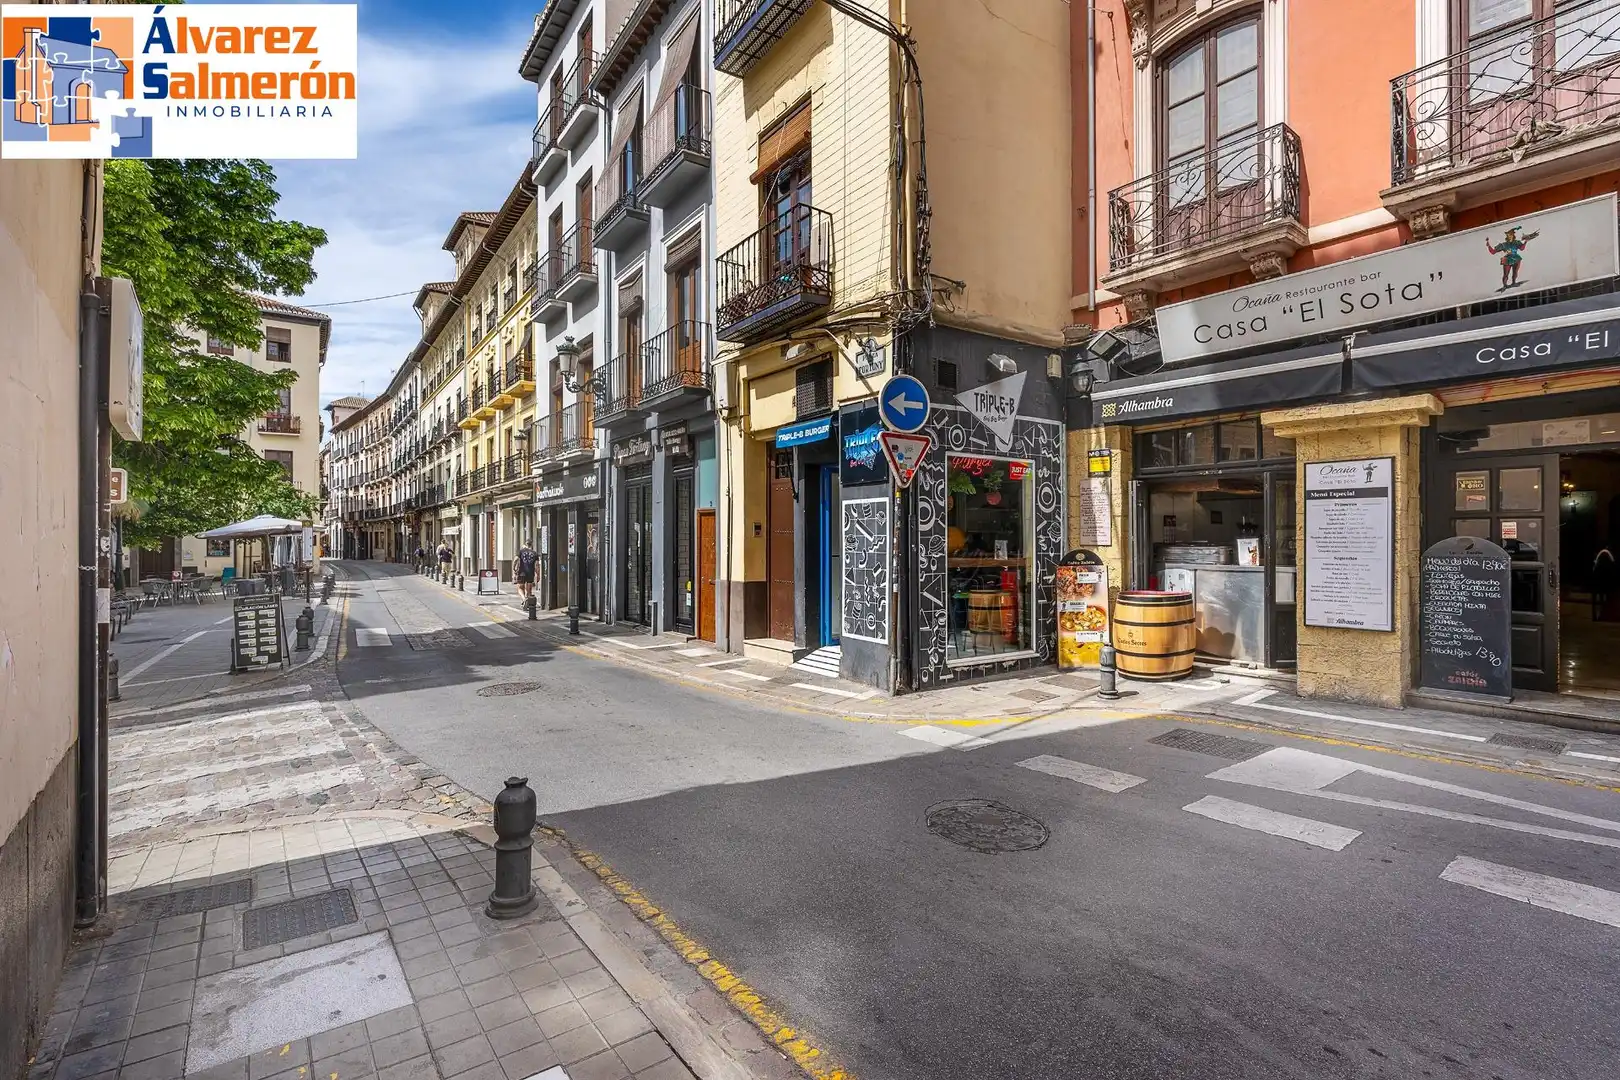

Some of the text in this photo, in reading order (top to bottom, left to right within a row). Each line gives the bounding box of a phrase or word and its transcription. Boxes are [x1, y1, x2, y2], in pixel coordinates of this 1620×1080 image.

[1232, 271, 1382, 313] Ocaña Restaurante bar
[1193, 315, 1268, 344] Casa
[1476, 342, 1551, 364] Casa
[1118, 397, 1173, 415] Alhambra
[778, 424, 830, 442] TRIPLE-B BURGER
[1011, 466, 1022, 474] JUST
[1329, 490, 1355, 498] Especial
[1335, 618, 1364, 626] Alhambra
